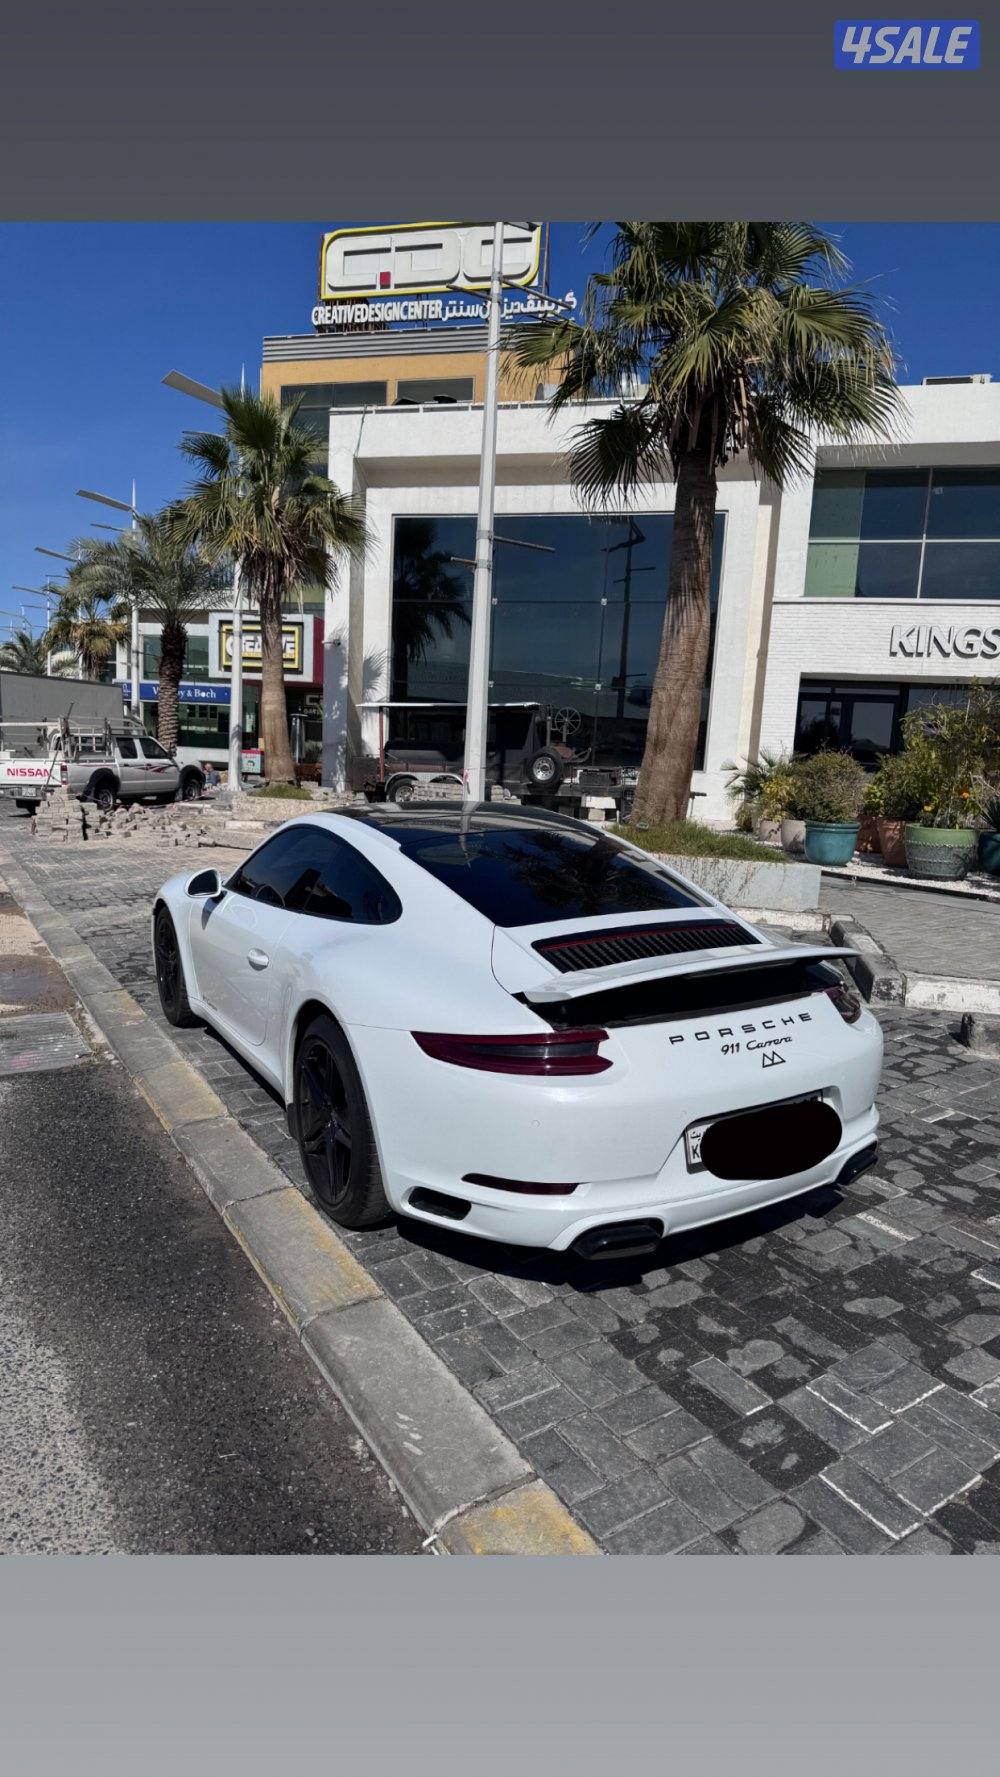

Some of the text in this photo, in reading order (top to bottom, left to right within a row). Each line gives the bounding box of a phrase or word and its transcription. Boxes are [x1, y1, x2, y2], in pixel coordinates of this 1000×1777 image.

[6, 768, 51, 777] NISSAN
[669, 1012, 812, 1045] PORSCHE
[721, 1035, 792, 1055] 911 Carrera
